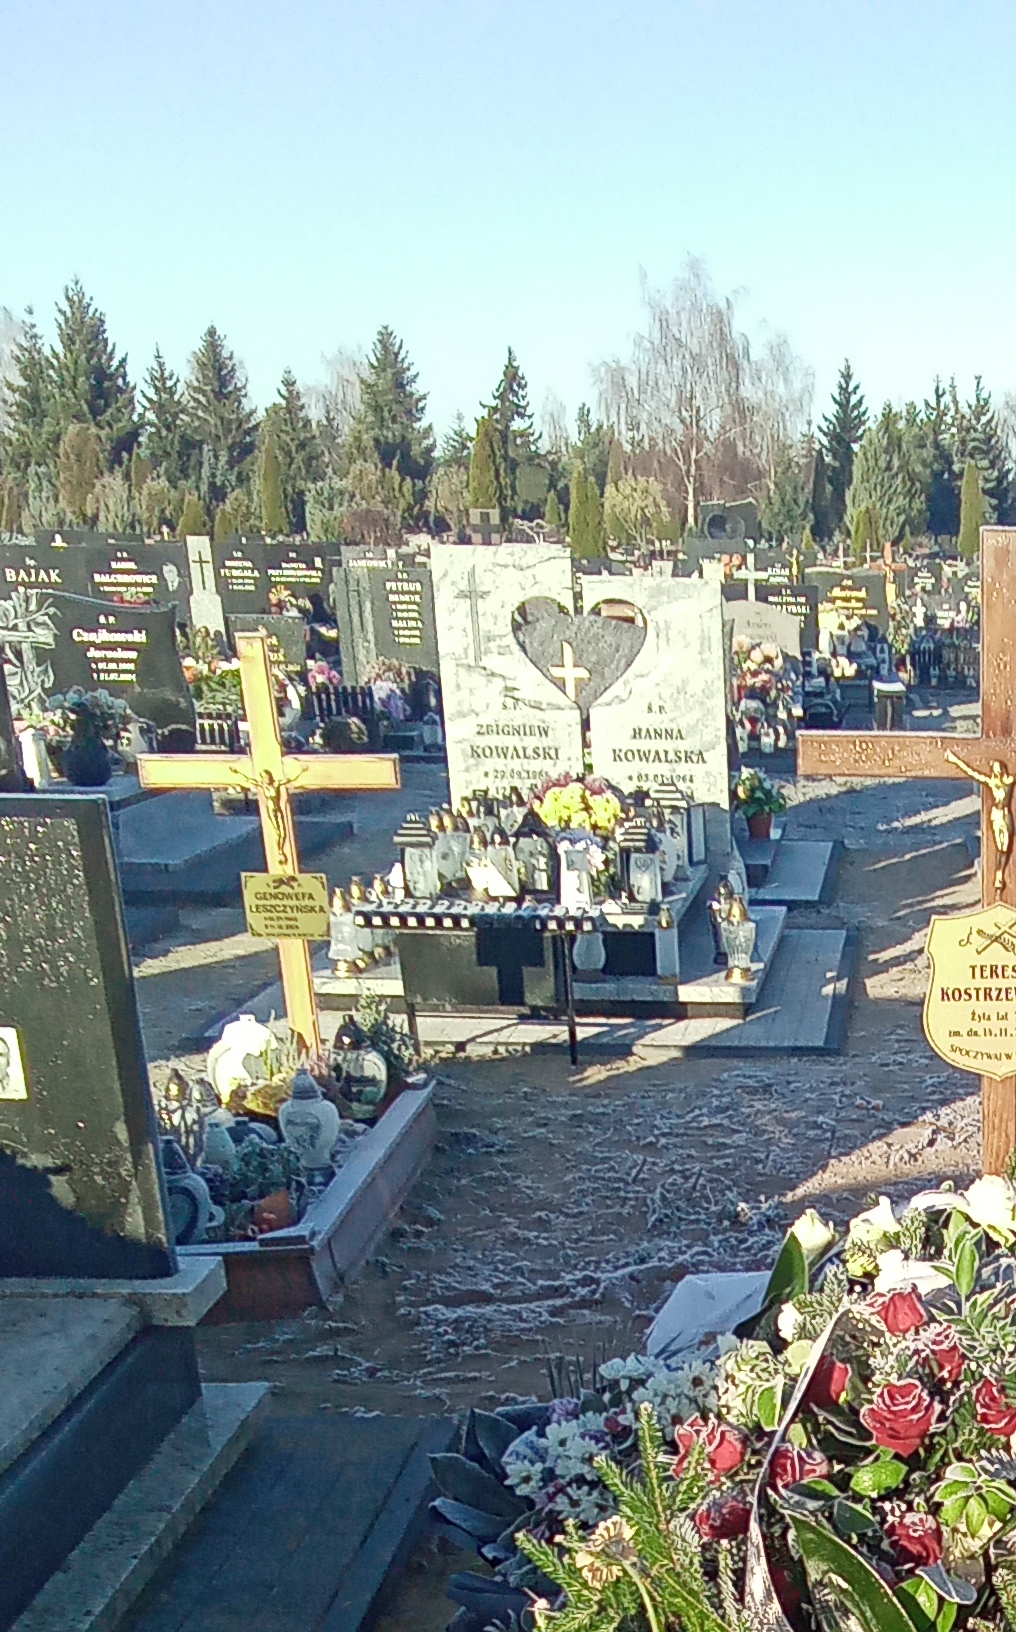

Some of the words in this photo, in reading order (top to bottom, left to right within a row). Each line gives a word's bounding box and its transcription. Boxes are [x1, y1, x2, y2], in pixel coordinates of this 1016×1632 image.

[5, 568, 62, 583] BAJAK
[476, 723, 550, 738] ZBIGNIEW
[631, 727, 685, 741] HANNA
[470, 745, 561, 760] KOWALSKI
[612, 748, 707, 764] KOWALSKA
[254, 892, 316, 901] GENOWEFA
[249, 903, 327, 914] LESZCZYŃSKA
[996, 1011, 1009, 1022] lat
[949, 1044, 1002, 1061] SPOCZYWAJ
[1004, 1052, 1013, 1061] W
